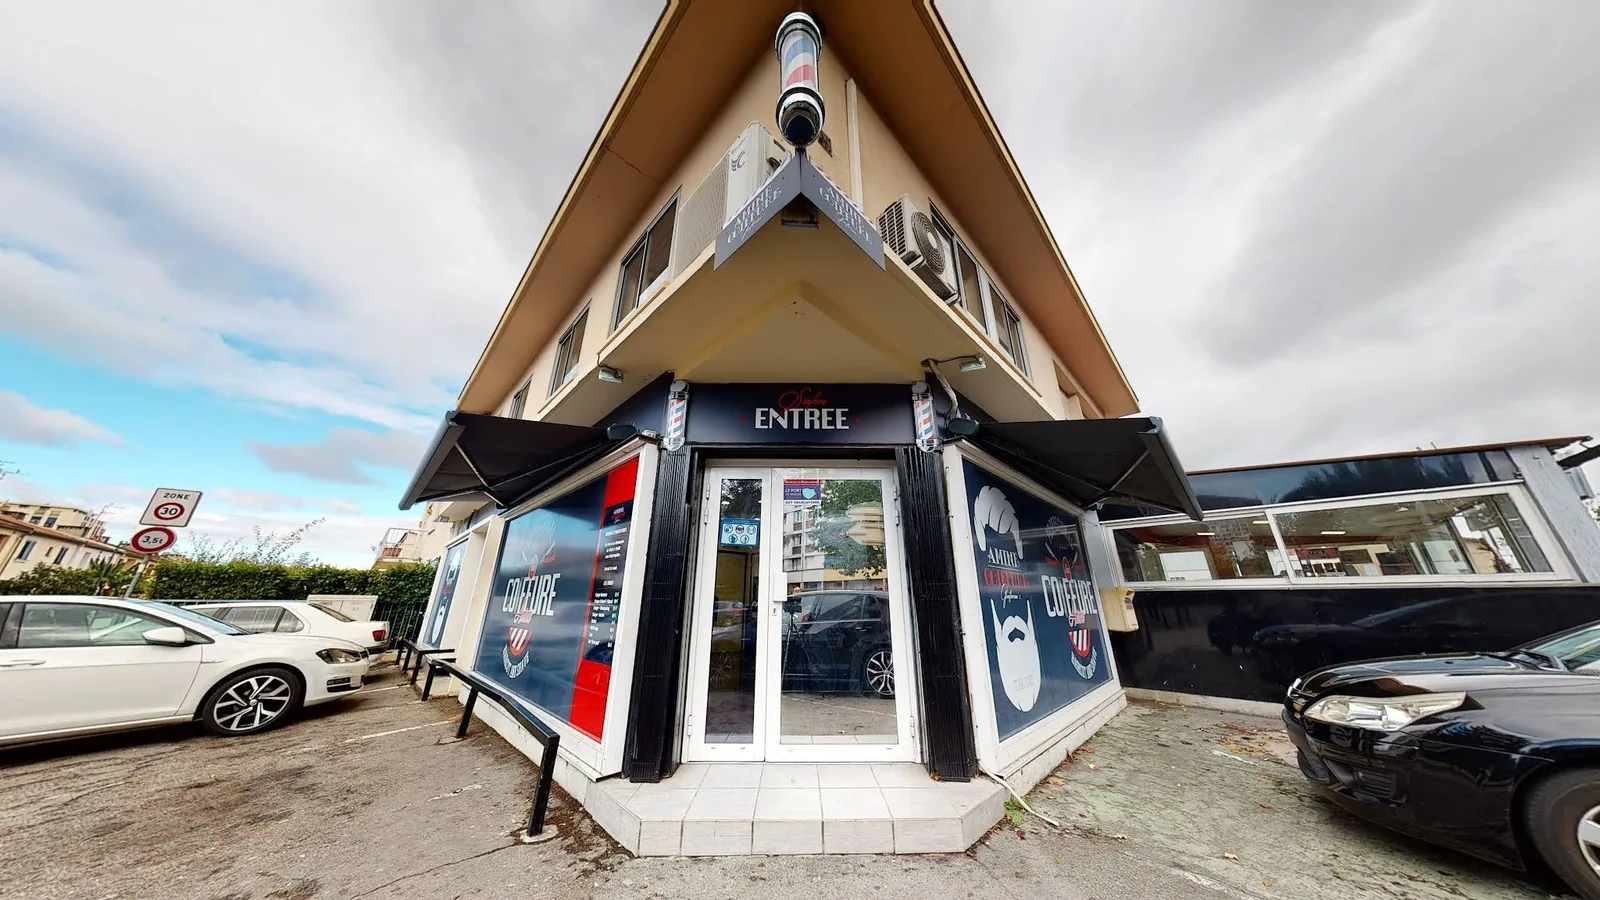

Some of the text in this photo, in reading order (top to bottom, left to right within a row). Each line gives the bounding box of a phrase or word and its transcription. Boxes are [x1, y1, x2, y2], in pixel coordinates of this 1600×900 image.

[727, 186, 782, 243] COIFFURE
[734, 185, 773, 229] AMINE
[755, 408, 850, 430] ENTREE
[163, 492, 191, 500] ZONE
[160, 507, 179, 516] 30
[142, 535, 164, 545] 3,5t
[988, 547, 1020, 568] AMINE
[502, 573, 561, 617] COIFFURE
[1041, 575, 1097, 619] COIFFURE
